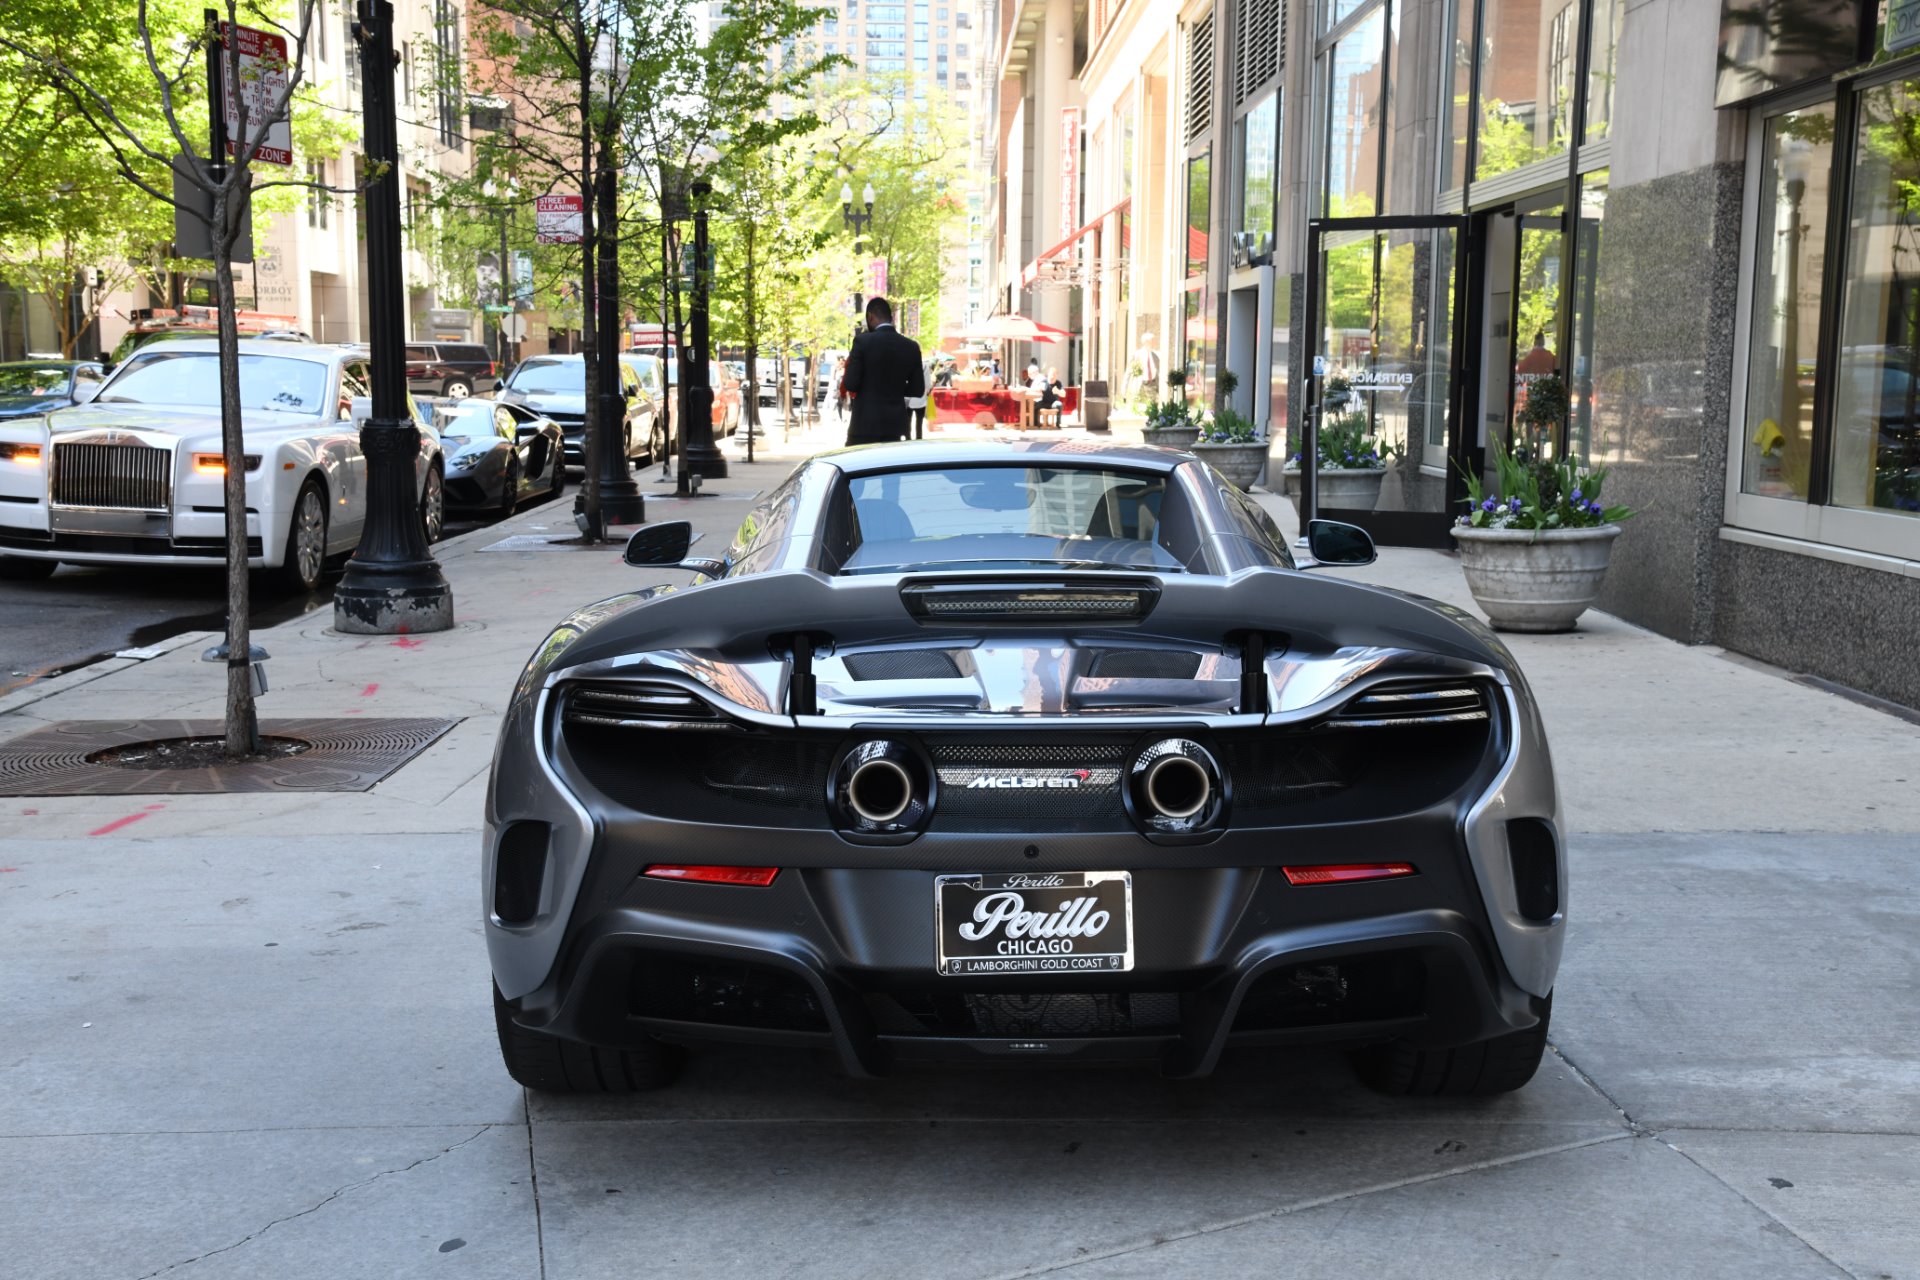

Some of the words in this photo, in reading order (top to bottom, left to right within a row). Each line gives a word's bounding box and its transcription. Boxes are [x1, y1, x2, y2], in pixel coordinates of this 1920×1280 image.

[259, 147, 286, 164] ZONE
[539, 196, 567, 205] STREET
[257, 286, 292, 295] ORBOY
[967, 775, 1079, 789] McLaren
[1003, 873, 1064, 889] Perillo
[959, 892, 1110, 940] Perillo
[997, 939, 1074, 955] CHICAGO
[967, 959, 1038, 971] LAMBORGHINI
[1040, 959, 1068, 969] GOLD
[1072, 958, 1104, 969] COAST
